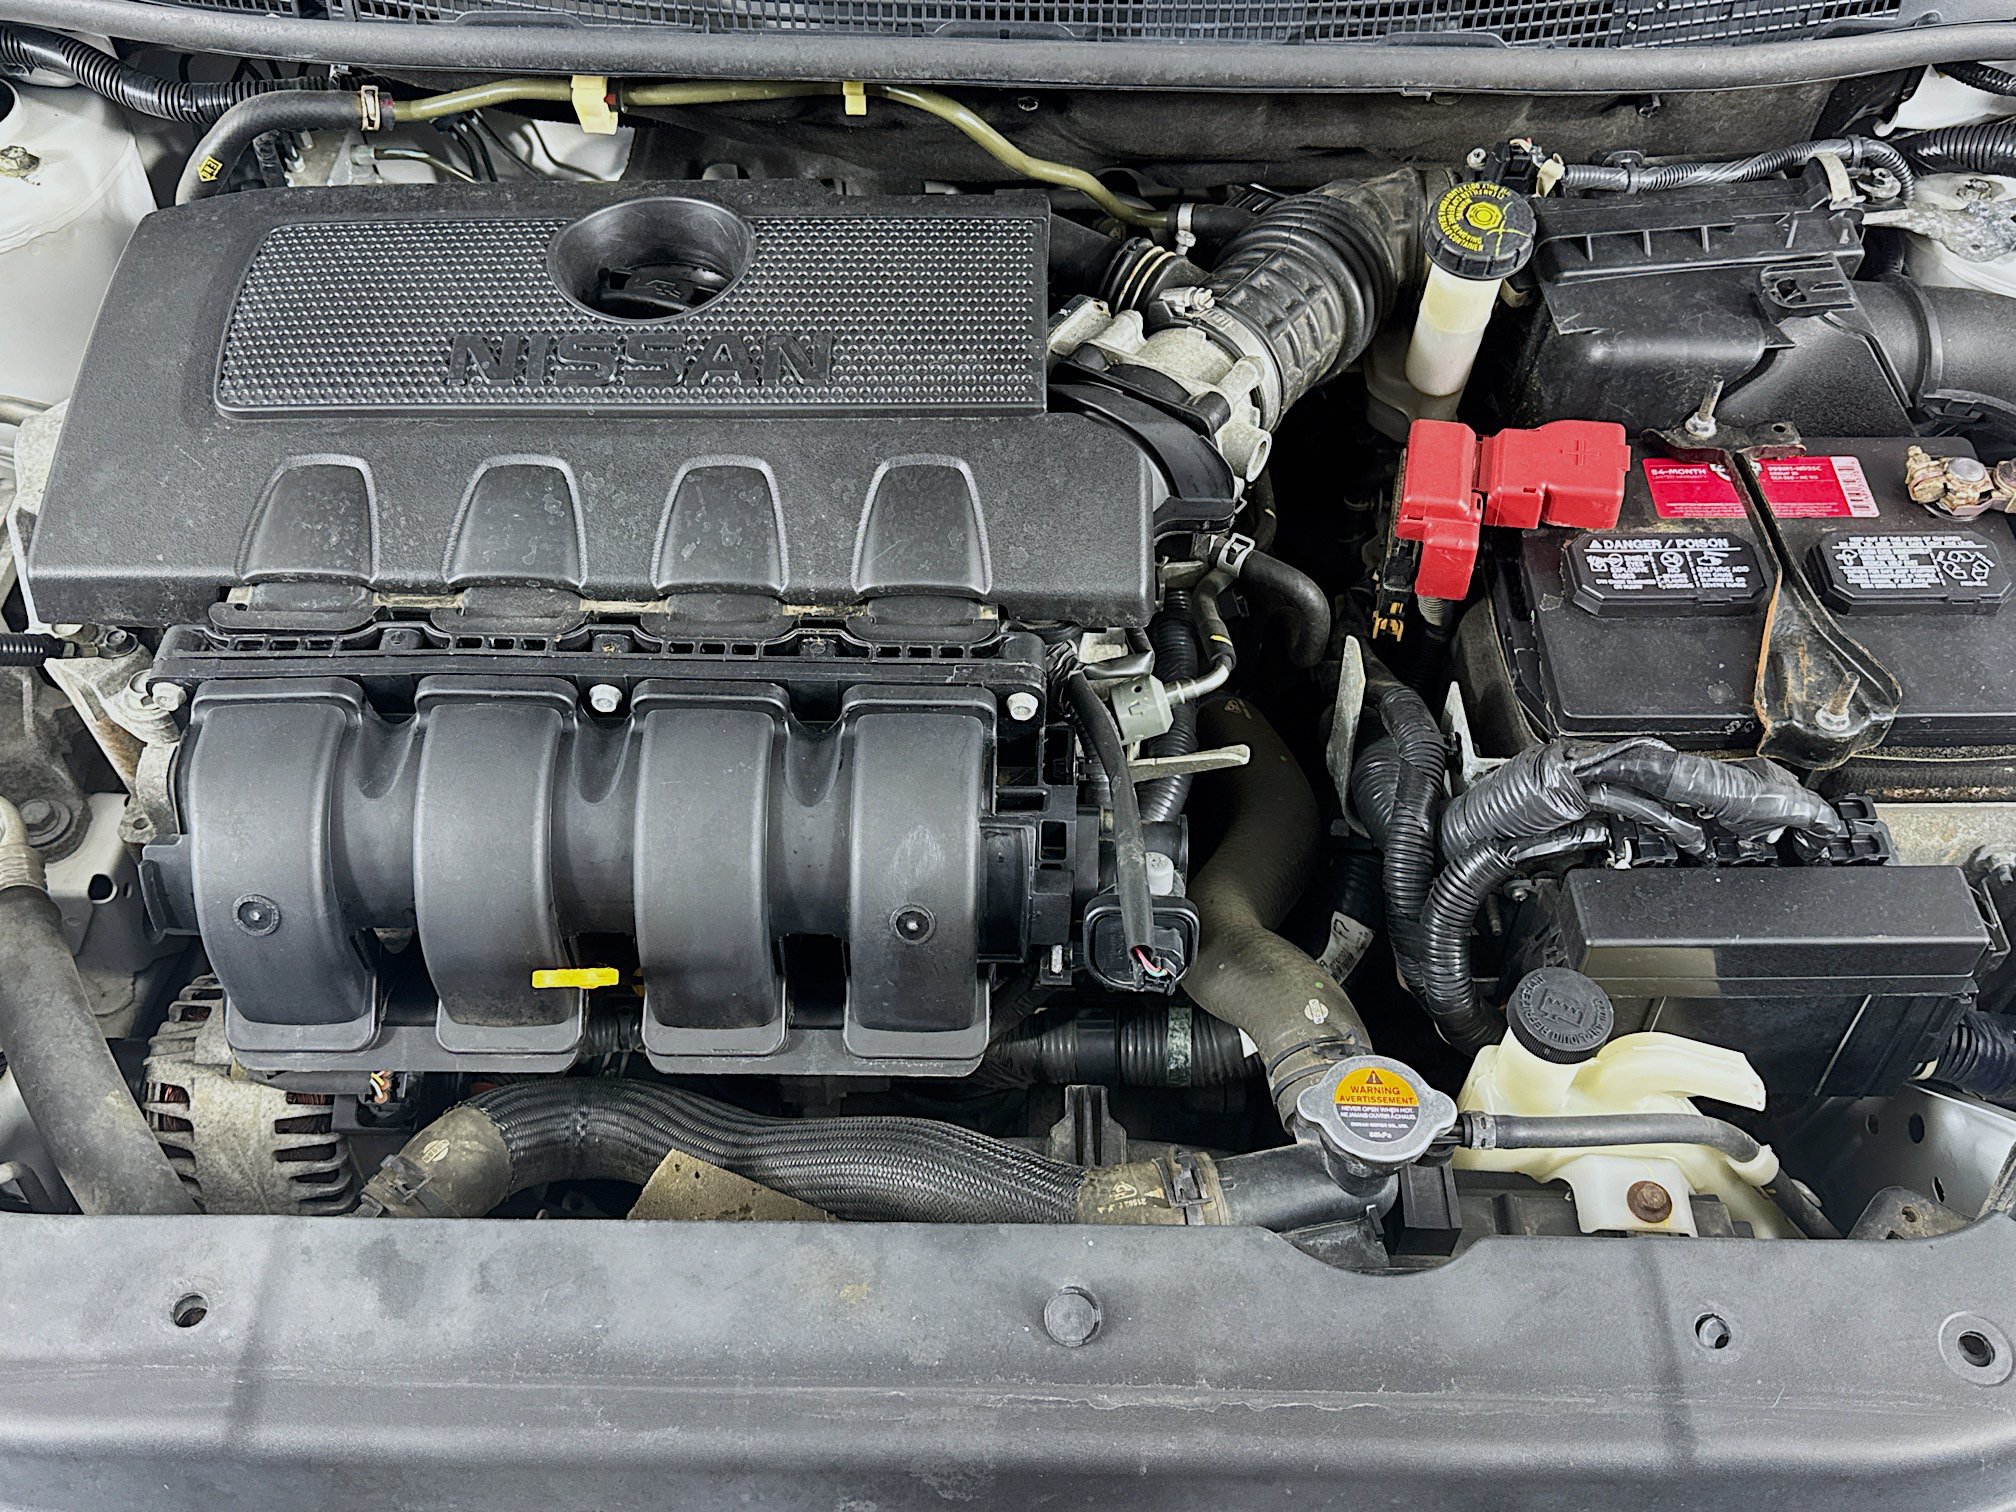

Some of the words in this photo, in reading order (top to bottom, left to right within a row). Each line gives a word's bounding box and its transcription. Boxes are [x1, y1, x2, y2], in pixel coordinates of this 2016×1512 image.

[1461, 188, 1482, 198] FILLER
[1447, 232, 1483, 252] CONTAINER
[448, 333, 834, 386] NISSAN
[1603, 539, 1662, 549] DANGER
[1675, 538, 1729, 548] POISON
[1350, 1085, 1400, 1095] WARNING
[1340, 1095, 1414, 1104] AVERTISSEMENT
